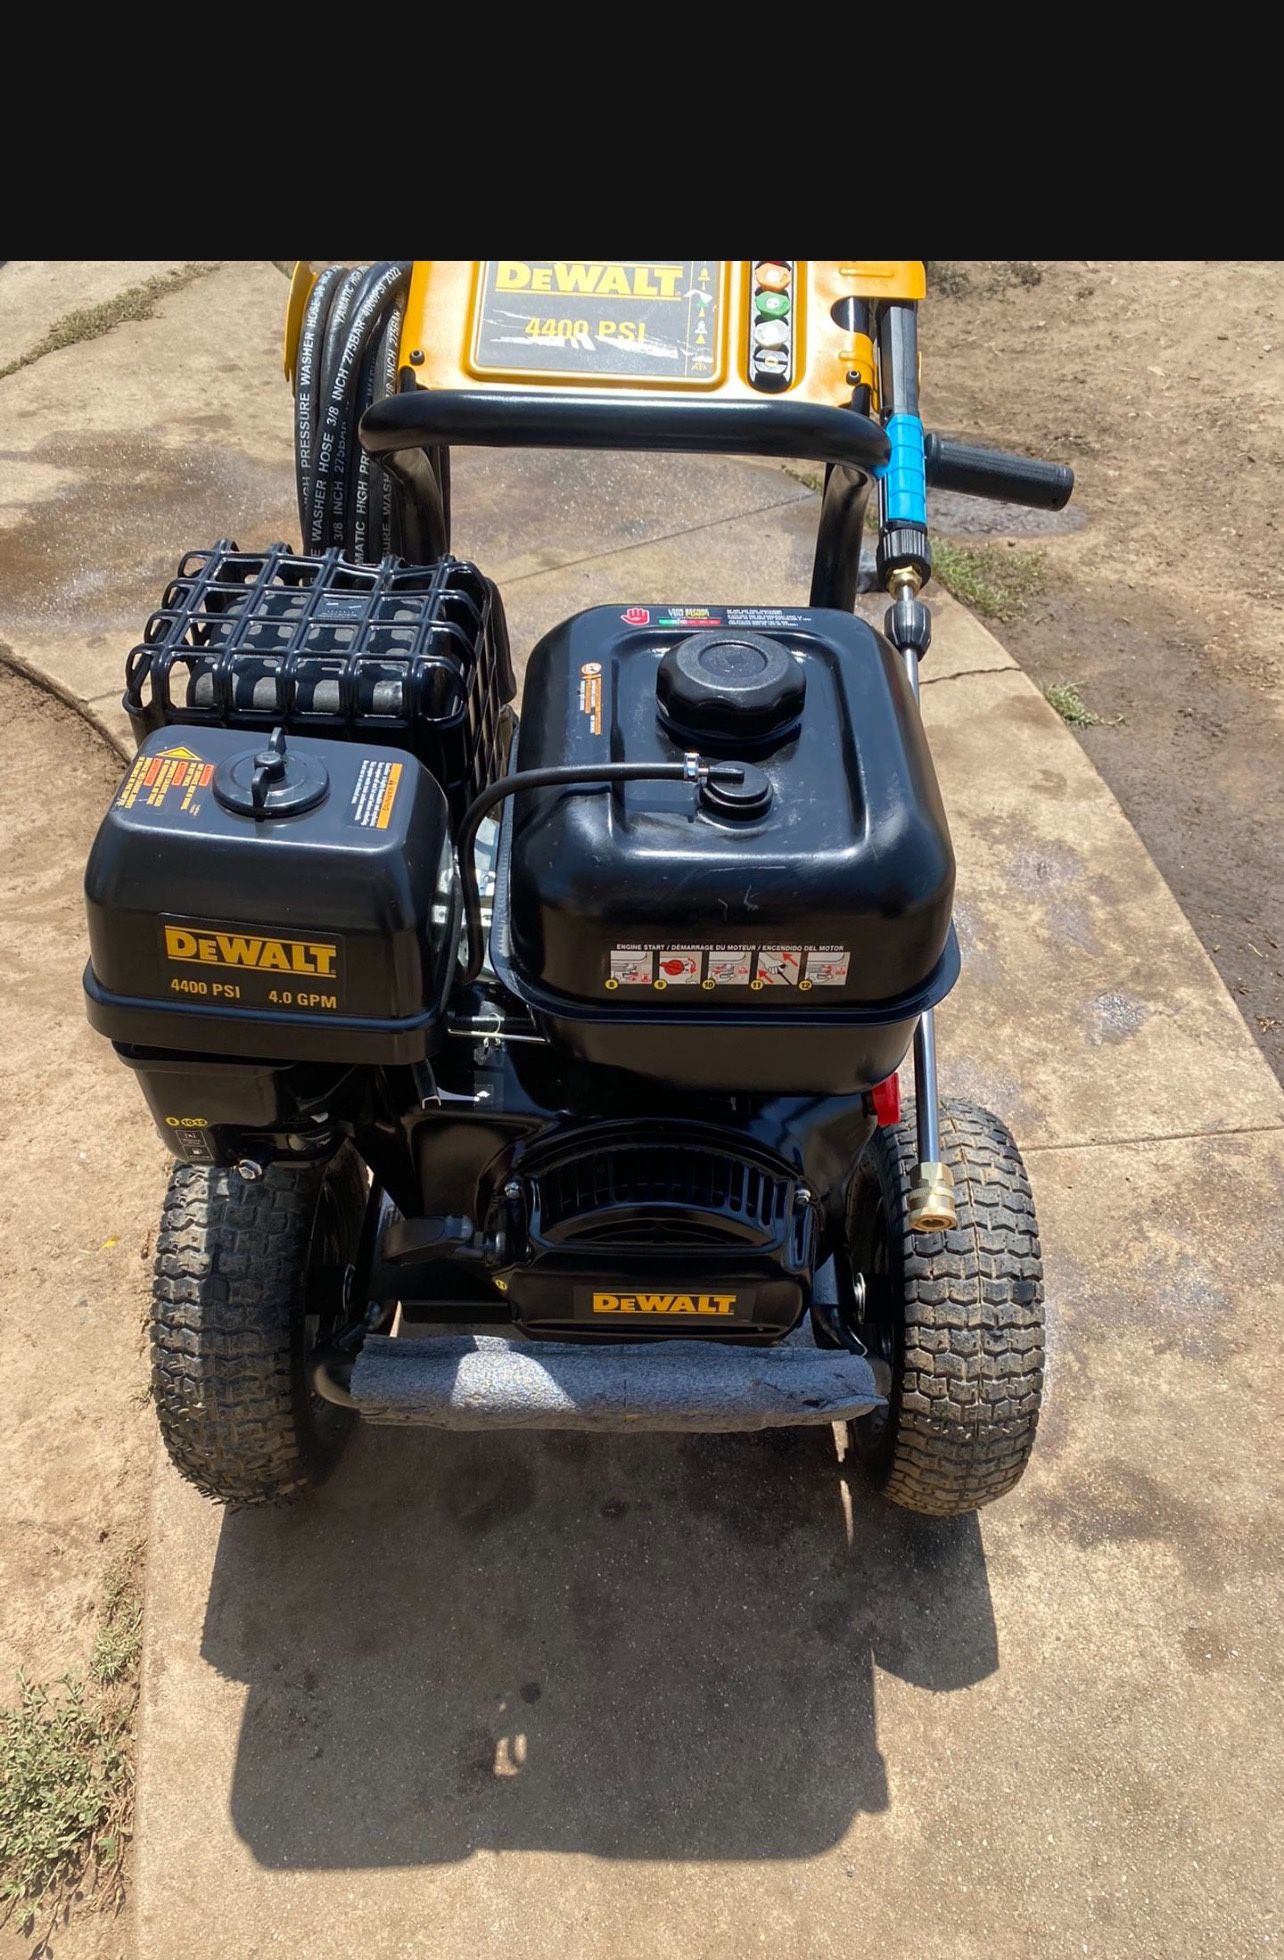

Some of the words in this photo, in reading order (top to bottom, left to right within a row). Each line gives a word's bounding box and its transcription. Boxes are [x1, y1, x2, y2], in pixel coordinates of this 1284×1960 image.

[307, 298, 321, 327] HOSE
[334, 284, 354, 324] YAMATIC
[362, 281, 387, 317] 4000PSI
[344, 317, 366, 365] 275BAR
[525, 317, 590, 340] 4400
[598, 320, 646, 343] PSI
[300, 332, 314, 386] WASHER
[386, 349, 397, 379] INCH
[331, 367, 349, 402] INCH
[299, 392, 311, 468] PRESSURE
[326, 405, 340, 428] 3/8
[318, 432, 335, 473] HOSE
[311, 480, 327, 541] WASHER
[333, 481, 344, 515] INCH
[356, 481, 368, 514] HIGH
[333, 522, 344, 540] 3/8
[165, 927, 337, 977] DEWALT
[671, 943, 714, 951] DÉMARRAGE
[171, 978, 207, 995] 4400
[212, 983, 241, 999] PSI
[268, 989, 292, 1005] 4.0
[297, 992, 337, 1009] GPM
[593, 1294, 735, 1314] DEWALT
